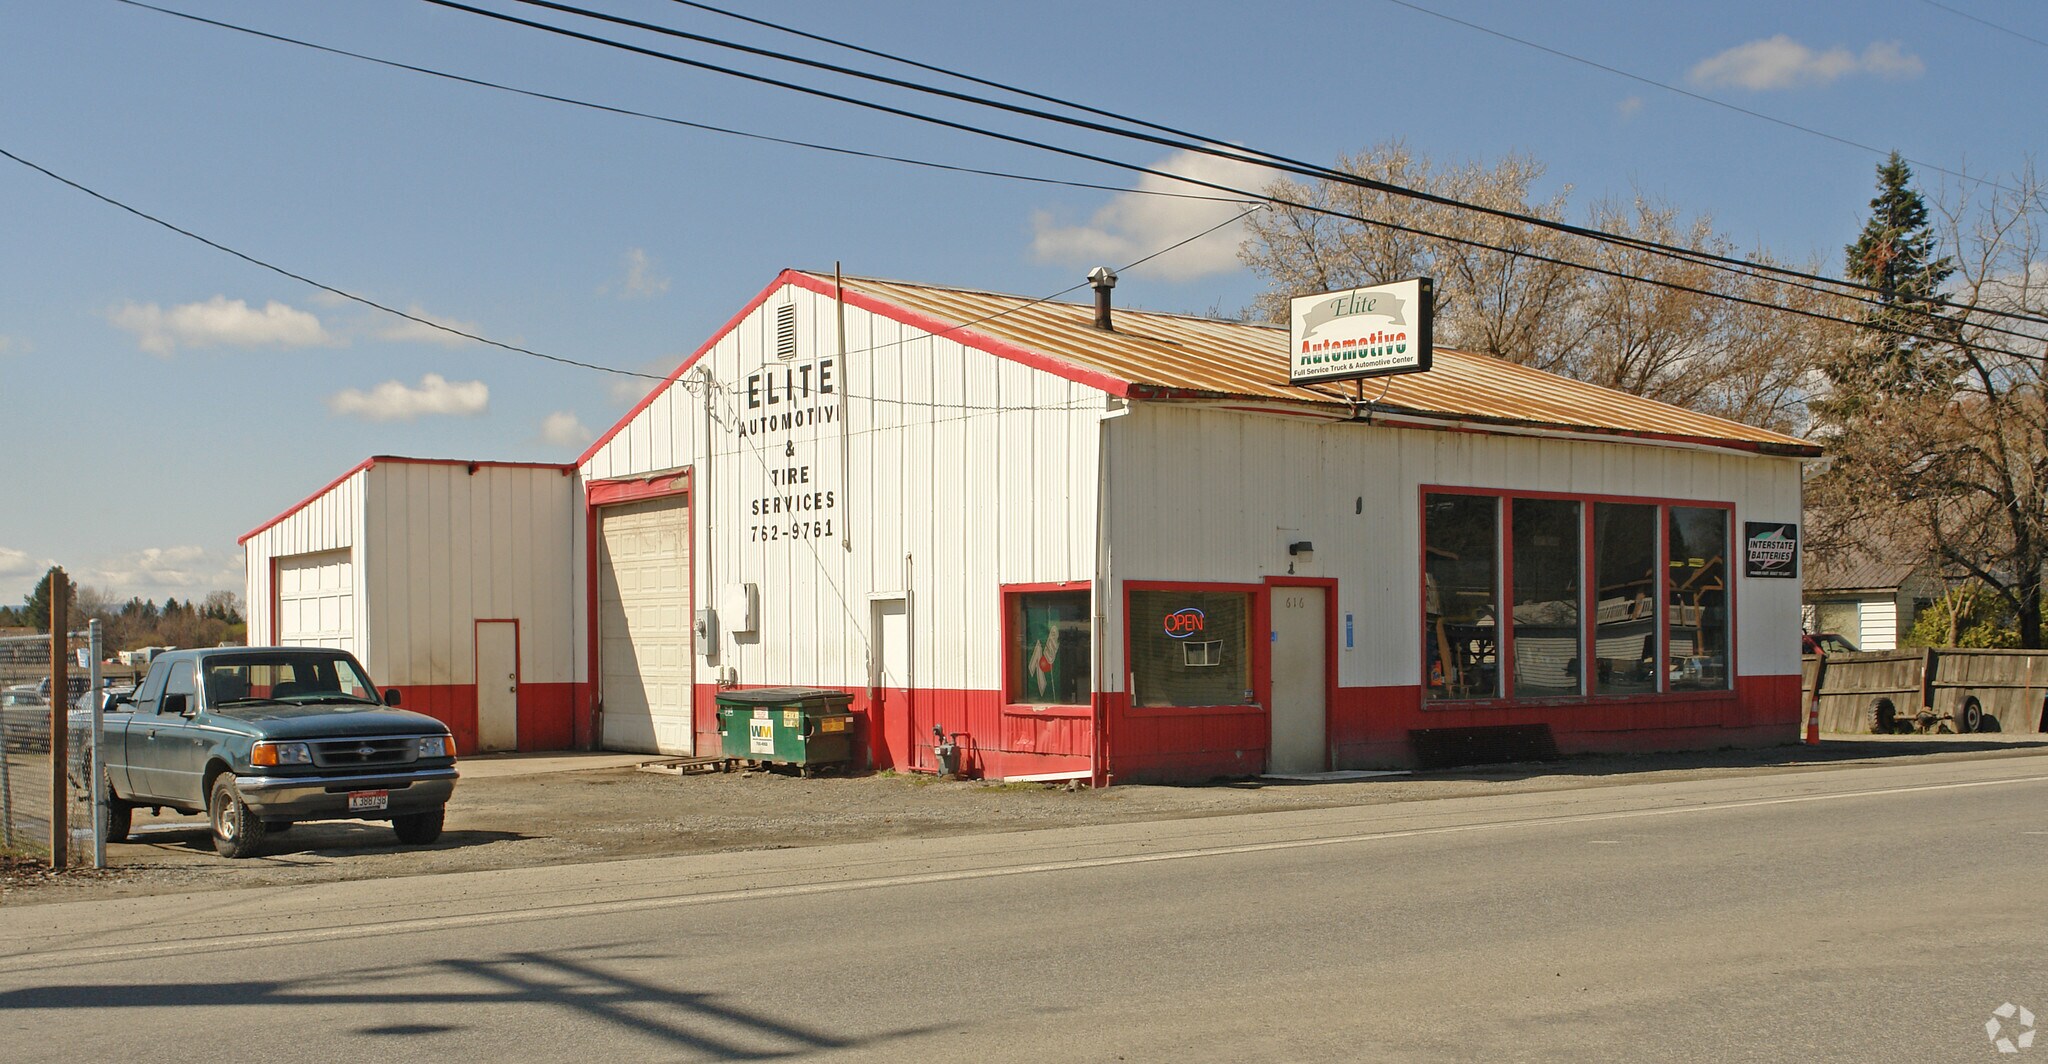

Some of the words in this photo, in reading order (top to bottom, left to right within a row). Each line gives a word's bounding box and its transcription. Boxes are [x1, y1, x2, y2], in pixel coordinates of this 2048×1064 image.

[1331, 289, 1377, 317] Elite
[1300, 331, 1406, 365] Automotive
[1294, 368, 1305, 376] Full
[1307, 367, 1328, 375] Service
[1355, 358, 1390, 368] Automotive
[1392, 356, 1413, 364] Center
[748, 360, 833, 409] ELITE
[785, 440, 794, 457] &
[772, 466, 809, 486] TIRE
[752, 491, 834, 515] SERVICES
[751, 519, 833, 542] 762-9761
[1750, 540, 1793, 550] INTERSTATE
[1751, 551, 1790, 560] BATTERIES
[1286, 597, 1304, 608] 616
[1164, 614, 1203, 632] OPEN
[751, 725, 772, 738] WM
